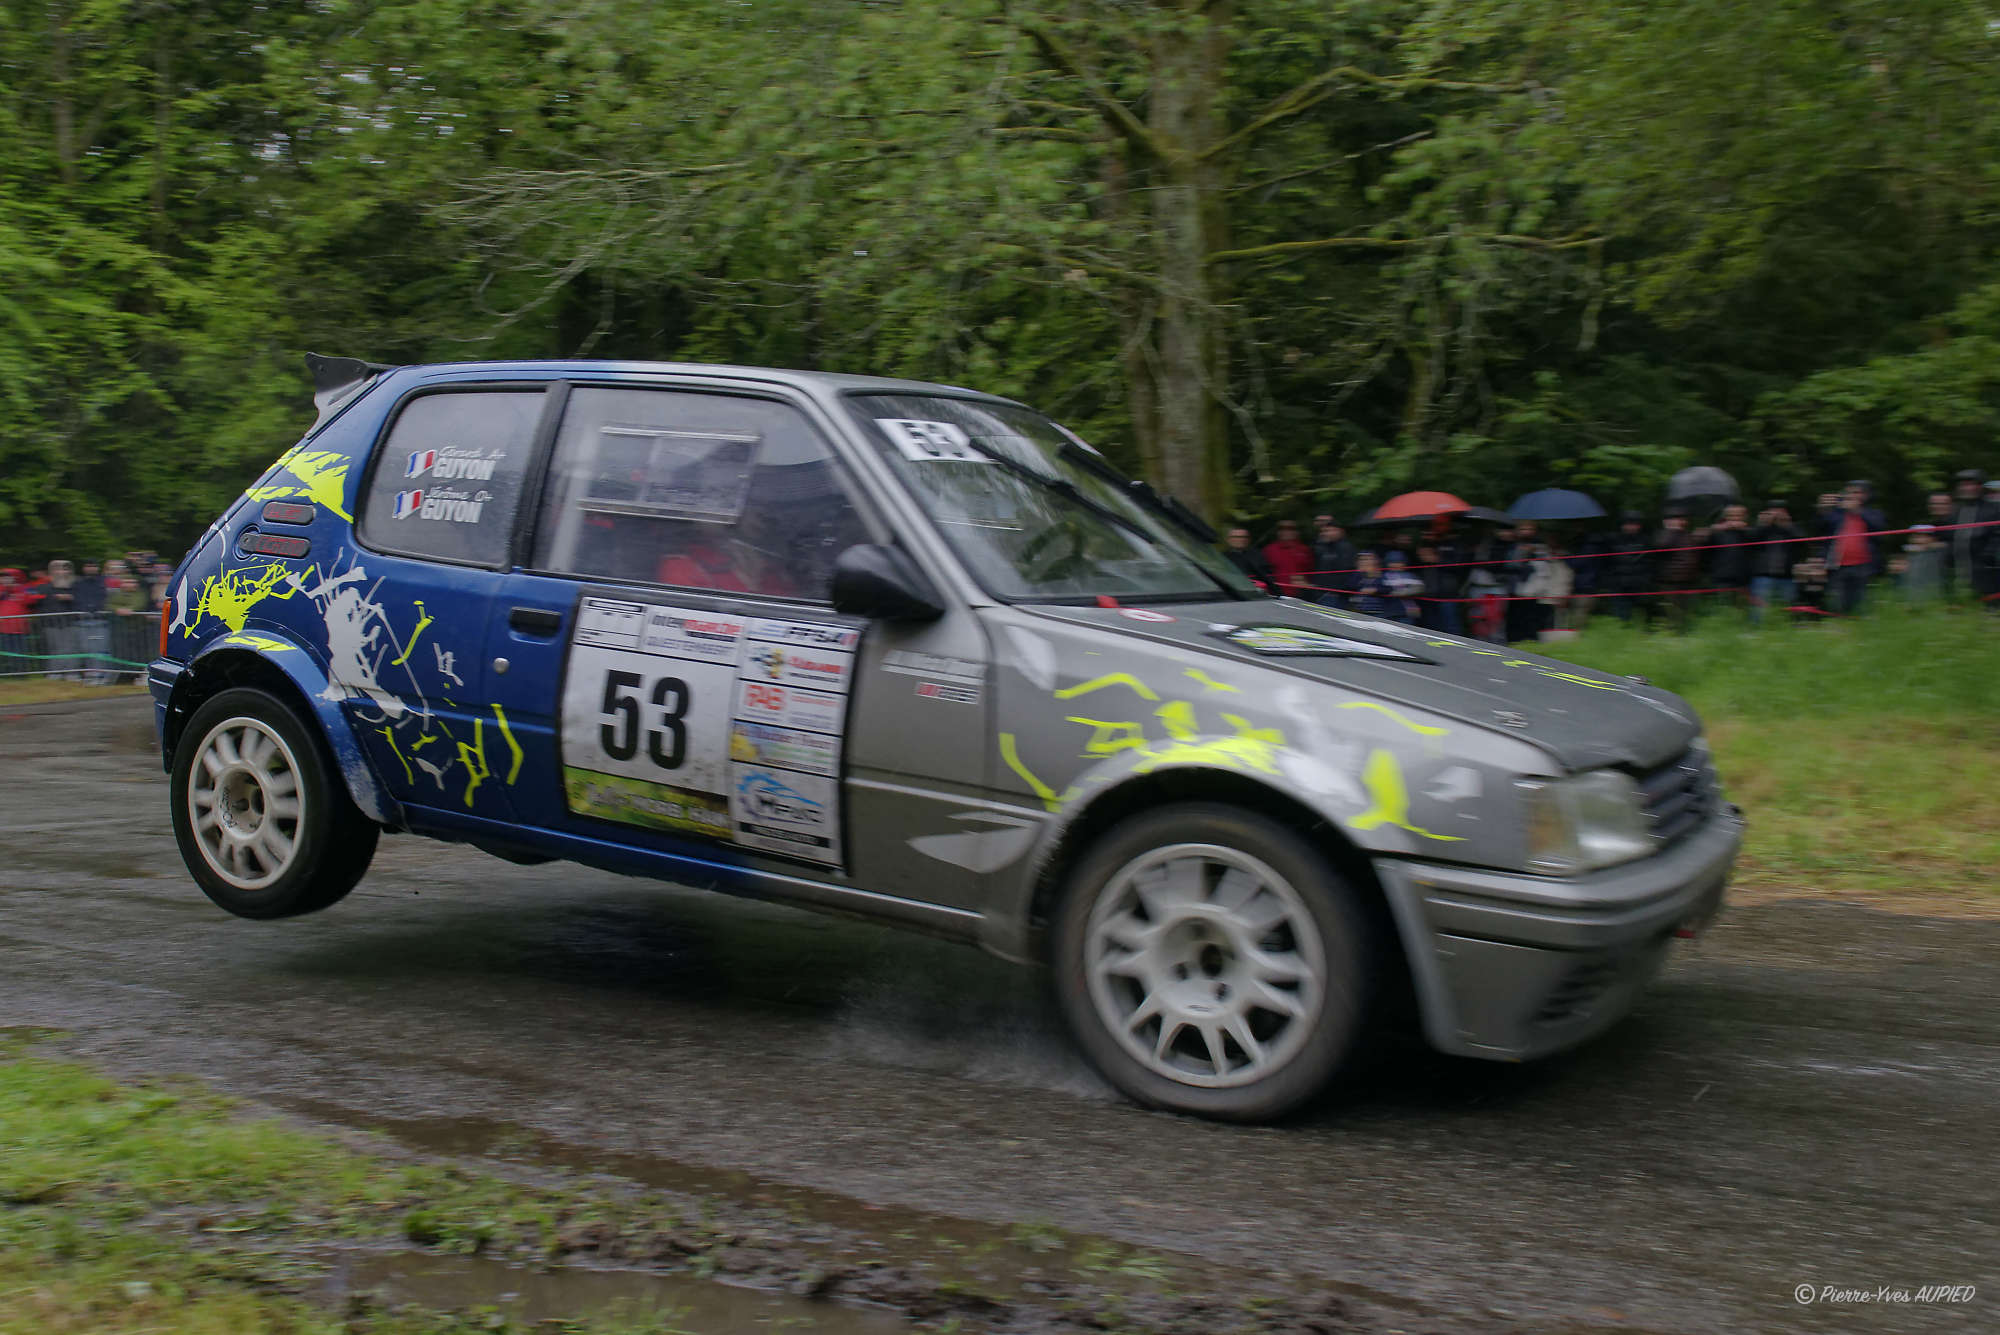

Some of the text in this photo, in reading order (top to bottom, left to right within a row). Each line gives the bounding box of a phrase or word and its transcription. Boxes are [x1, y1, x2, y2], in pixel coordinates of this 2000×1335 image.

[432, 458, 496, 480] GUYON
[421, 499, 483, 523] GUYON
[601, 669, 690, 770] 53
